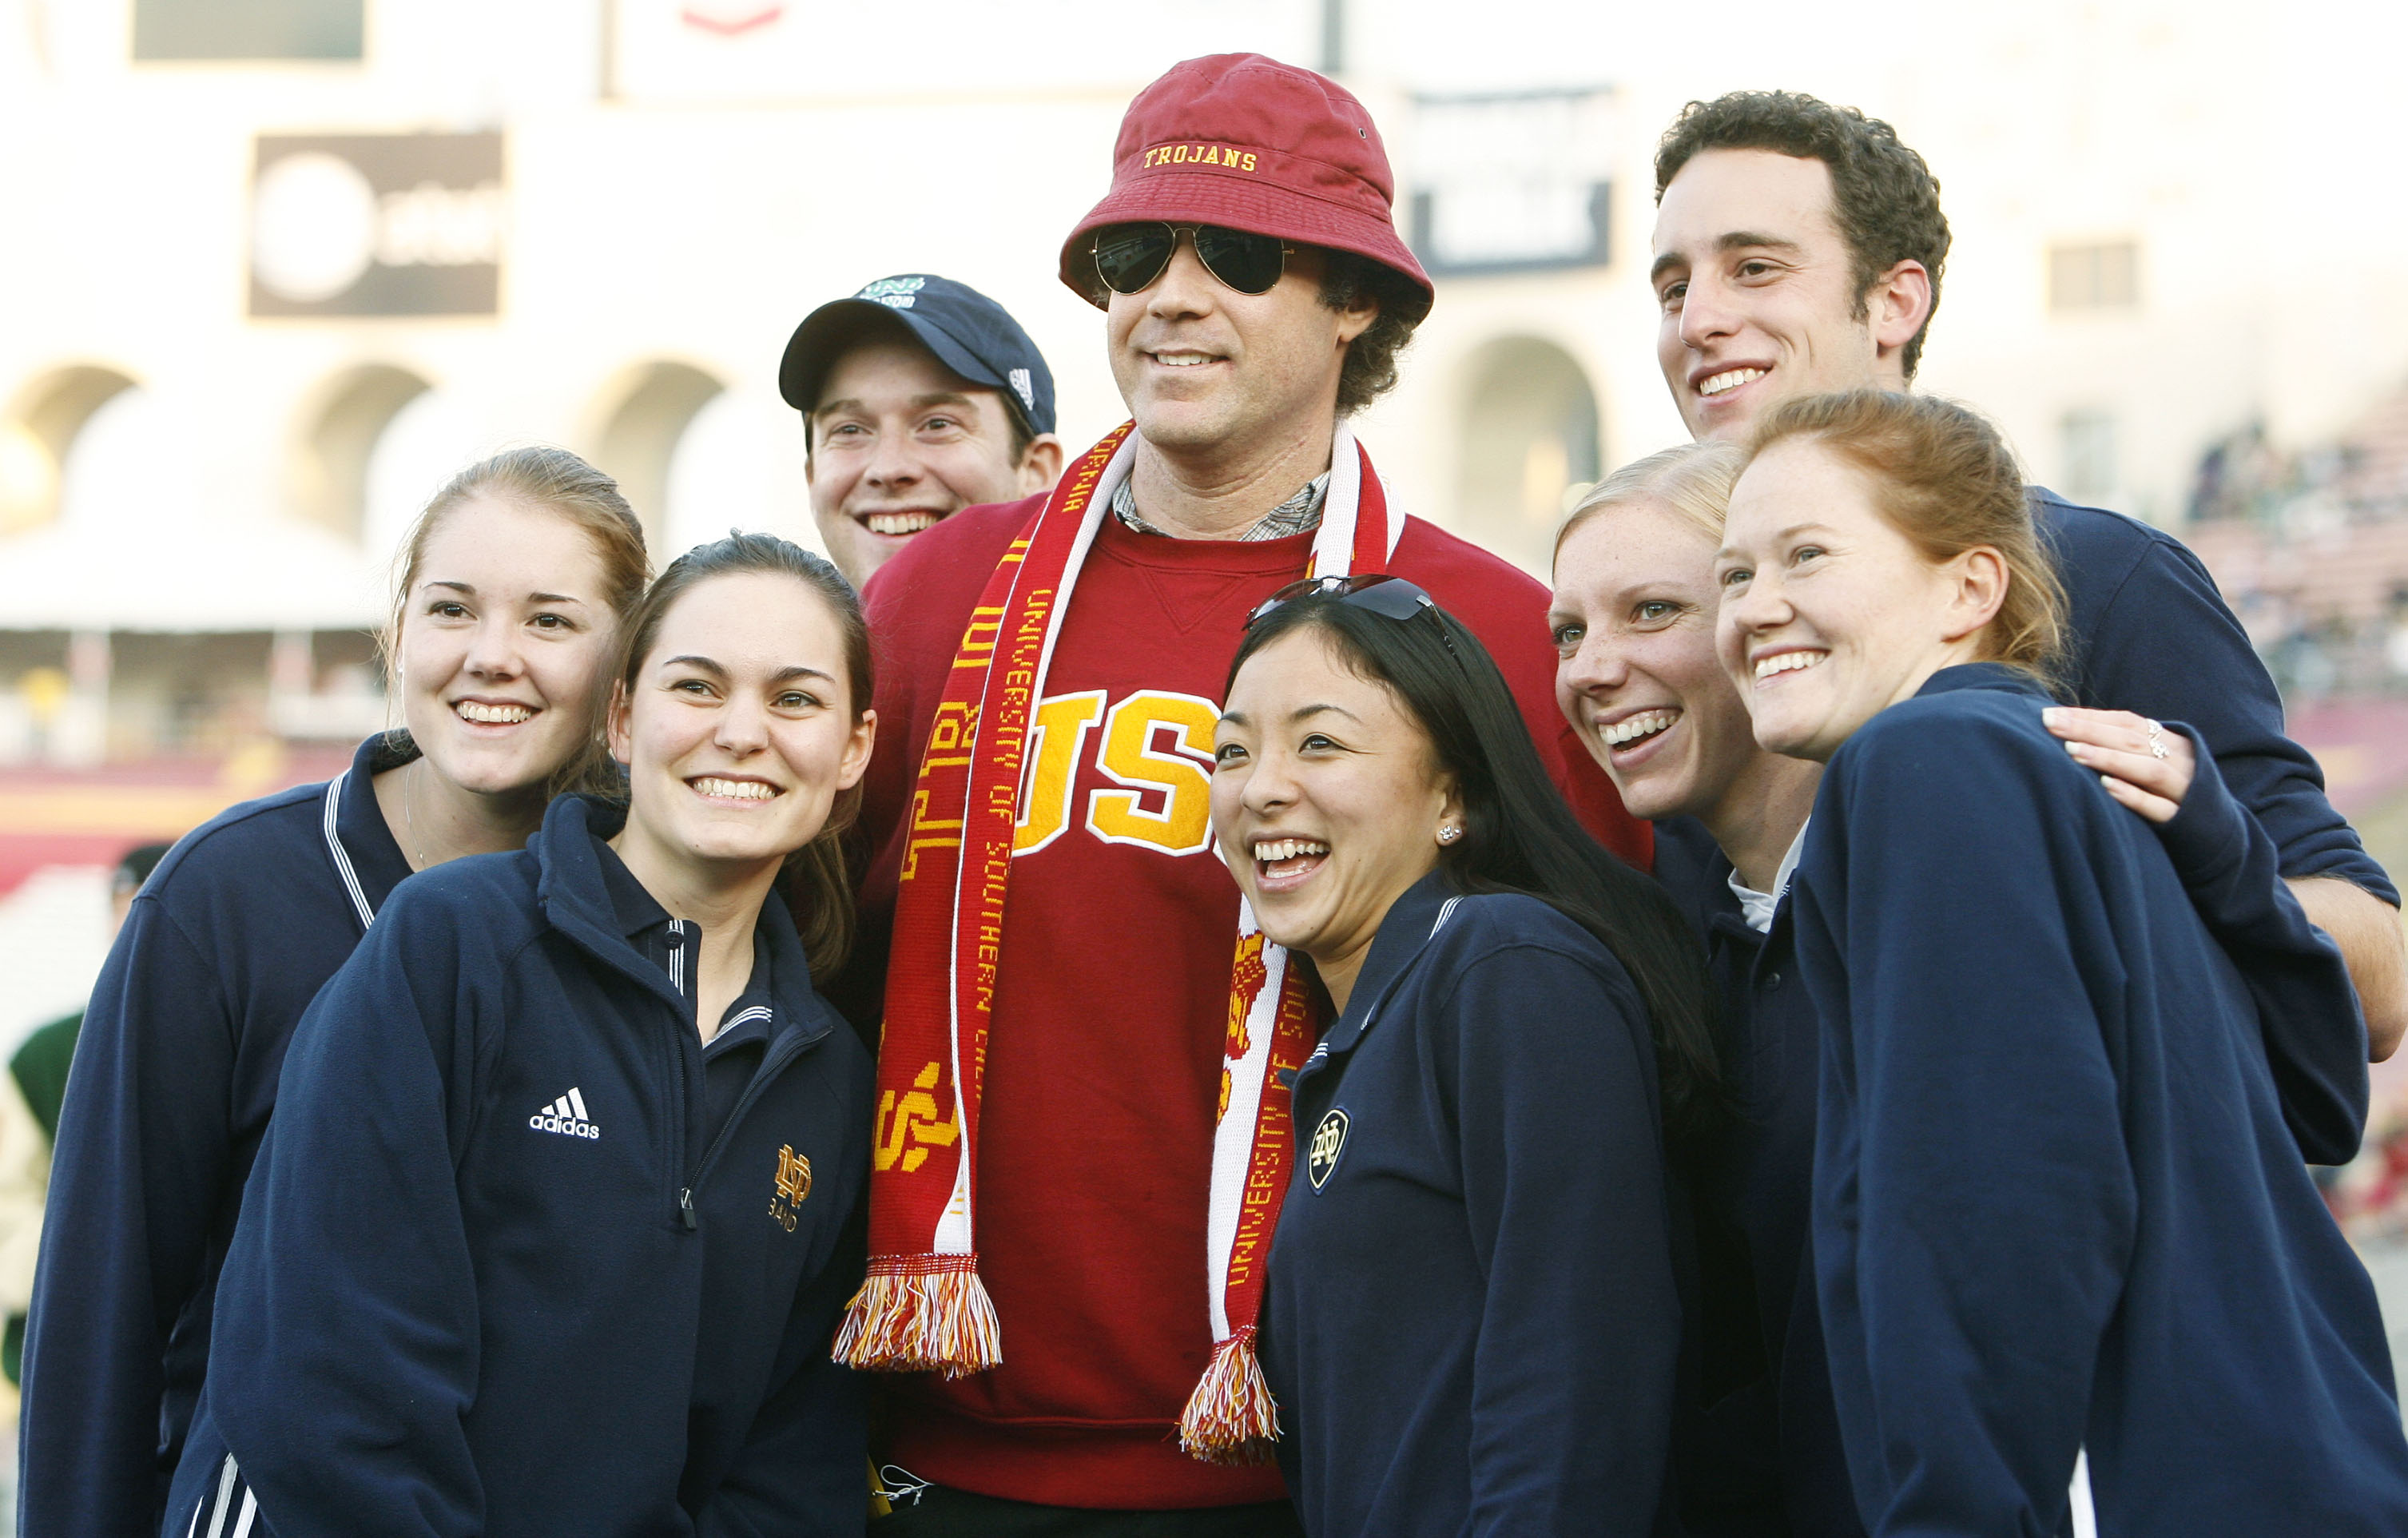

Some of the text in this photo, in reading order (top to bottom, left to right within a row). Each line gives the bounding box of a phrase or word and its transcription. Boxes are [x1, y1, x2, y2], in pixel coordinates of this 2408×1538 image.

[1143, 145, 1258, 172] TROJANS
[1061, 422, 1133, 512] IFORNIA
[992, 588, 1052, 769] UNIVERSITY
[987, 784, 1015, 825] OF
[976, 841, 1010, 1013] SOUTHERN
[529, 1114, 600, 1139] adidas
[1228, 1105, 1289, 1286] UNIVERSITY
